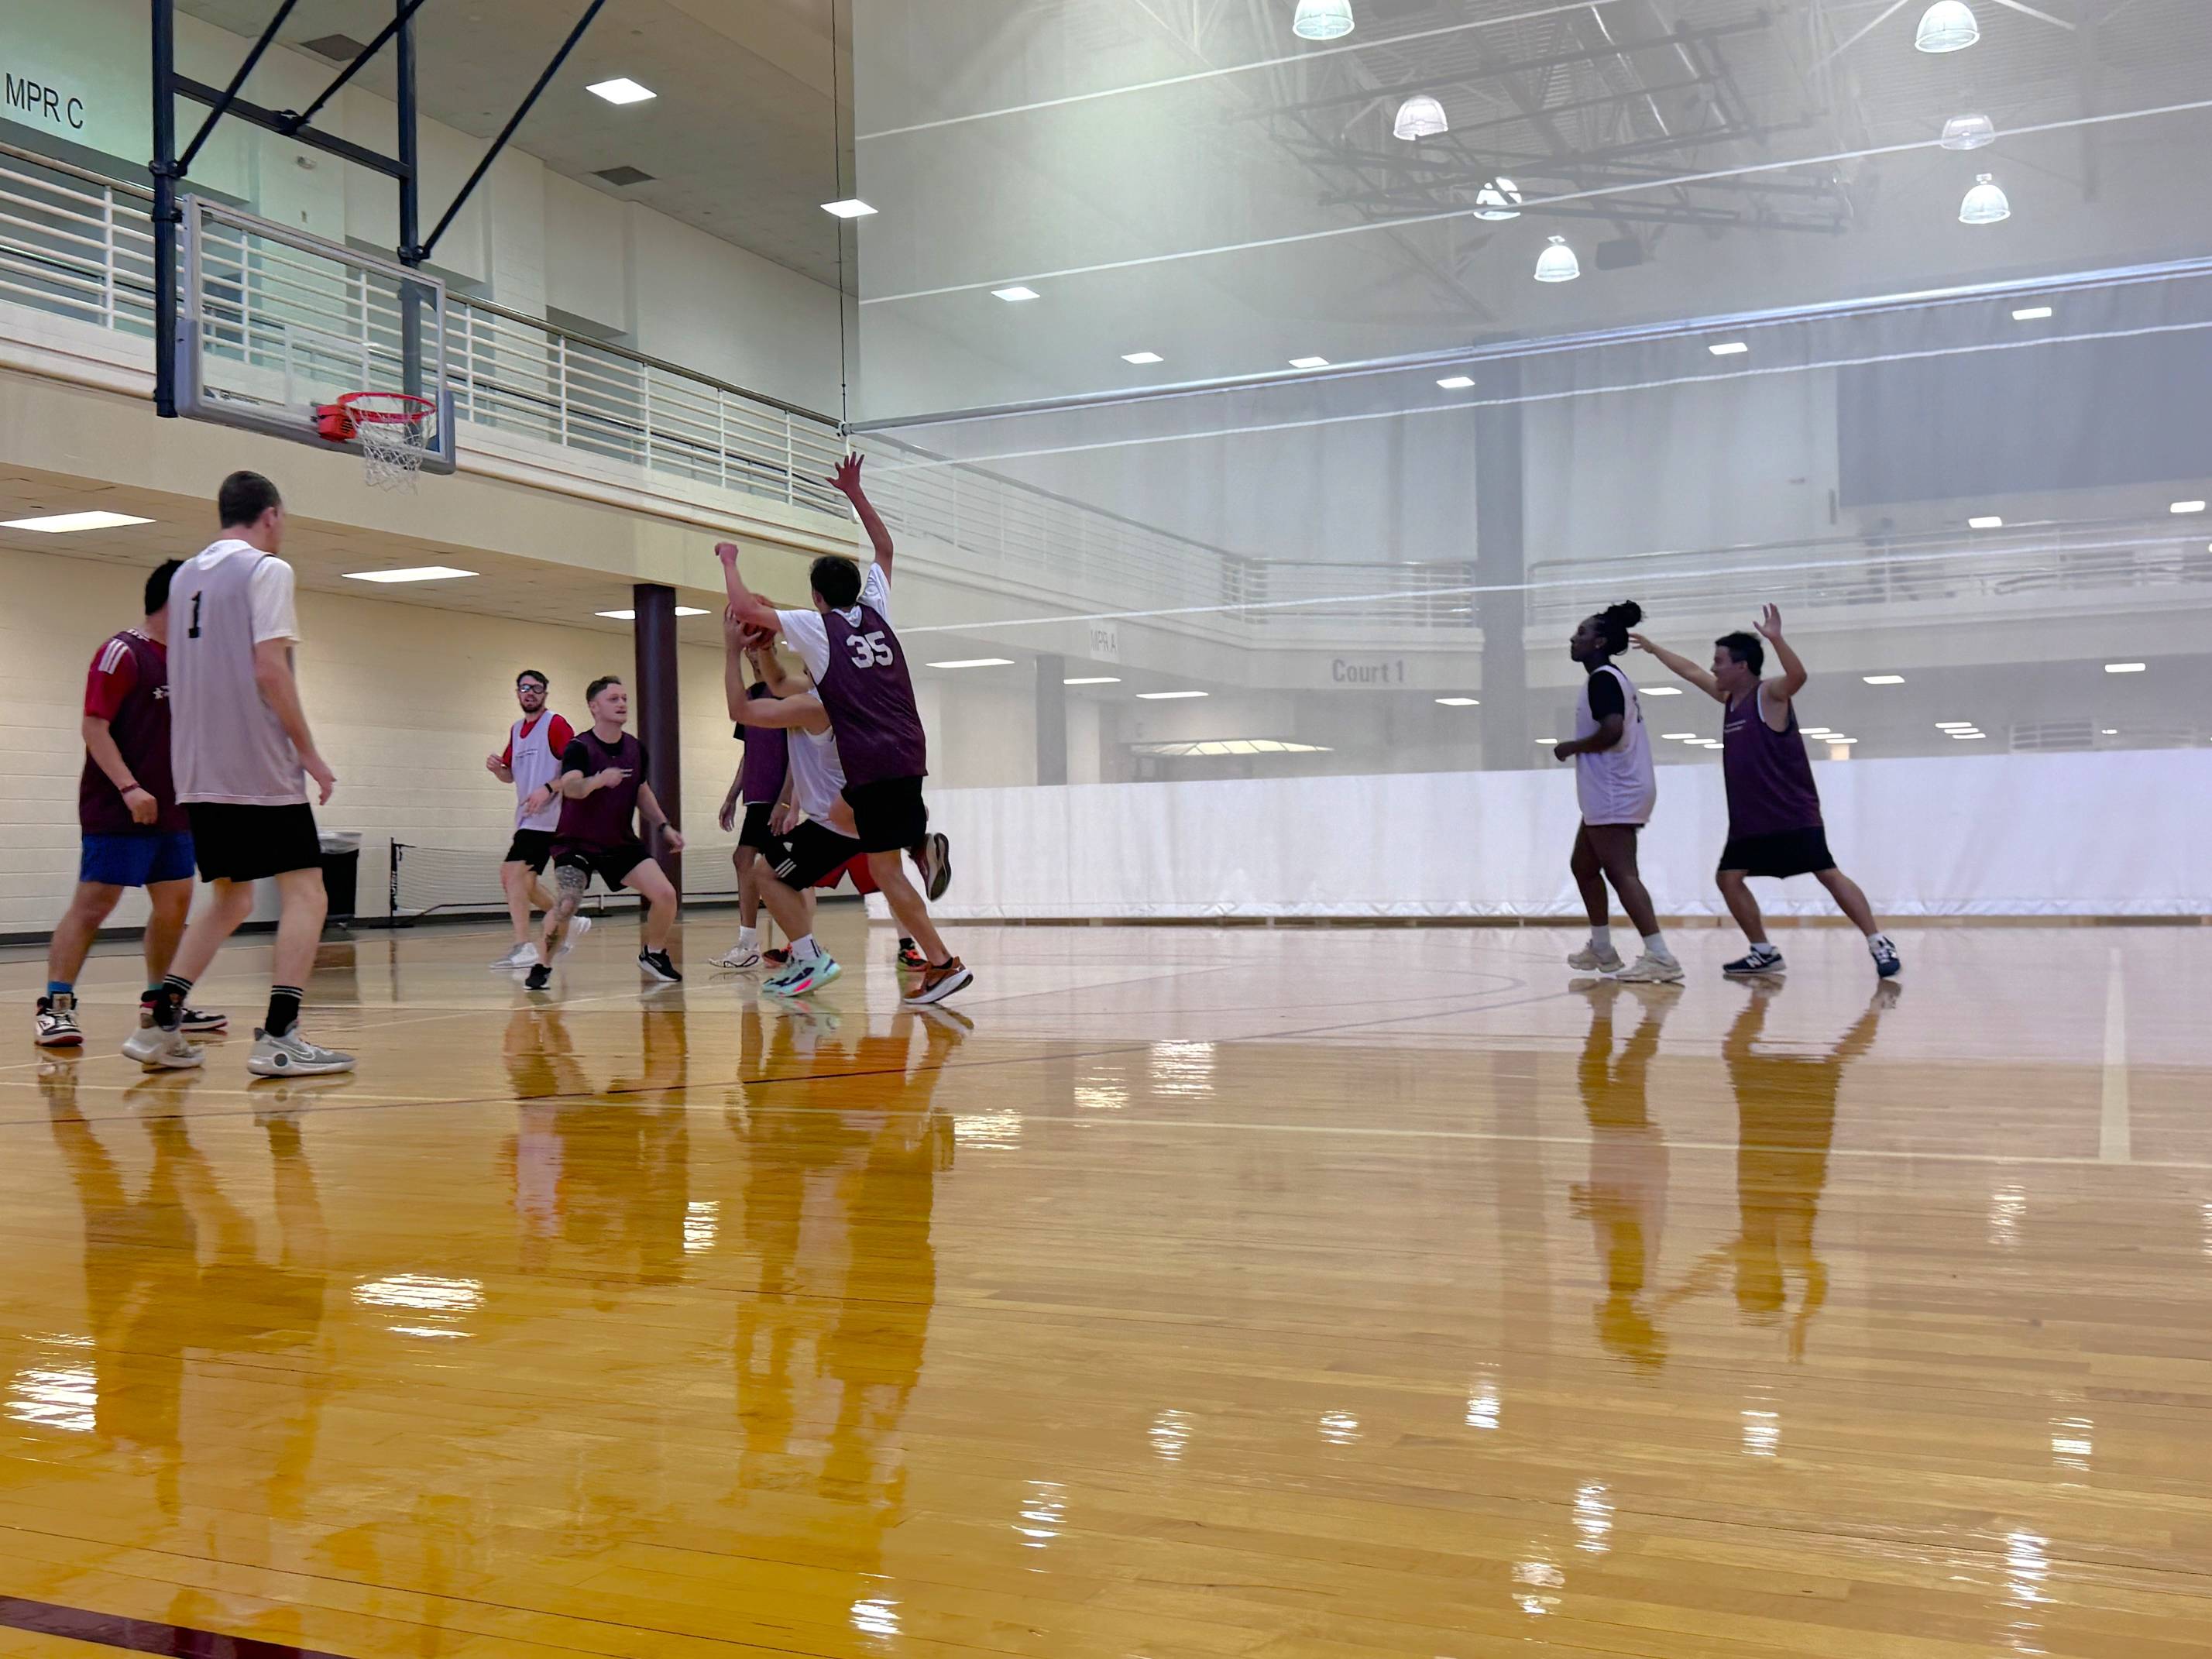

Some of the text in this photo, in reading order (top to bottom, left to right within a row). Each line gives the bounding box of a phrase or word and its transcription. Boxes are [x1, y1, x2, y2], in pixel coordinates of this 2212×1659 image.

[6, 72, 84, 129] MPR C
[187, 590, 201, 639] 1
[847, 630, 894, 669] 35
[1332, 658, 1403, 682] Court 1
